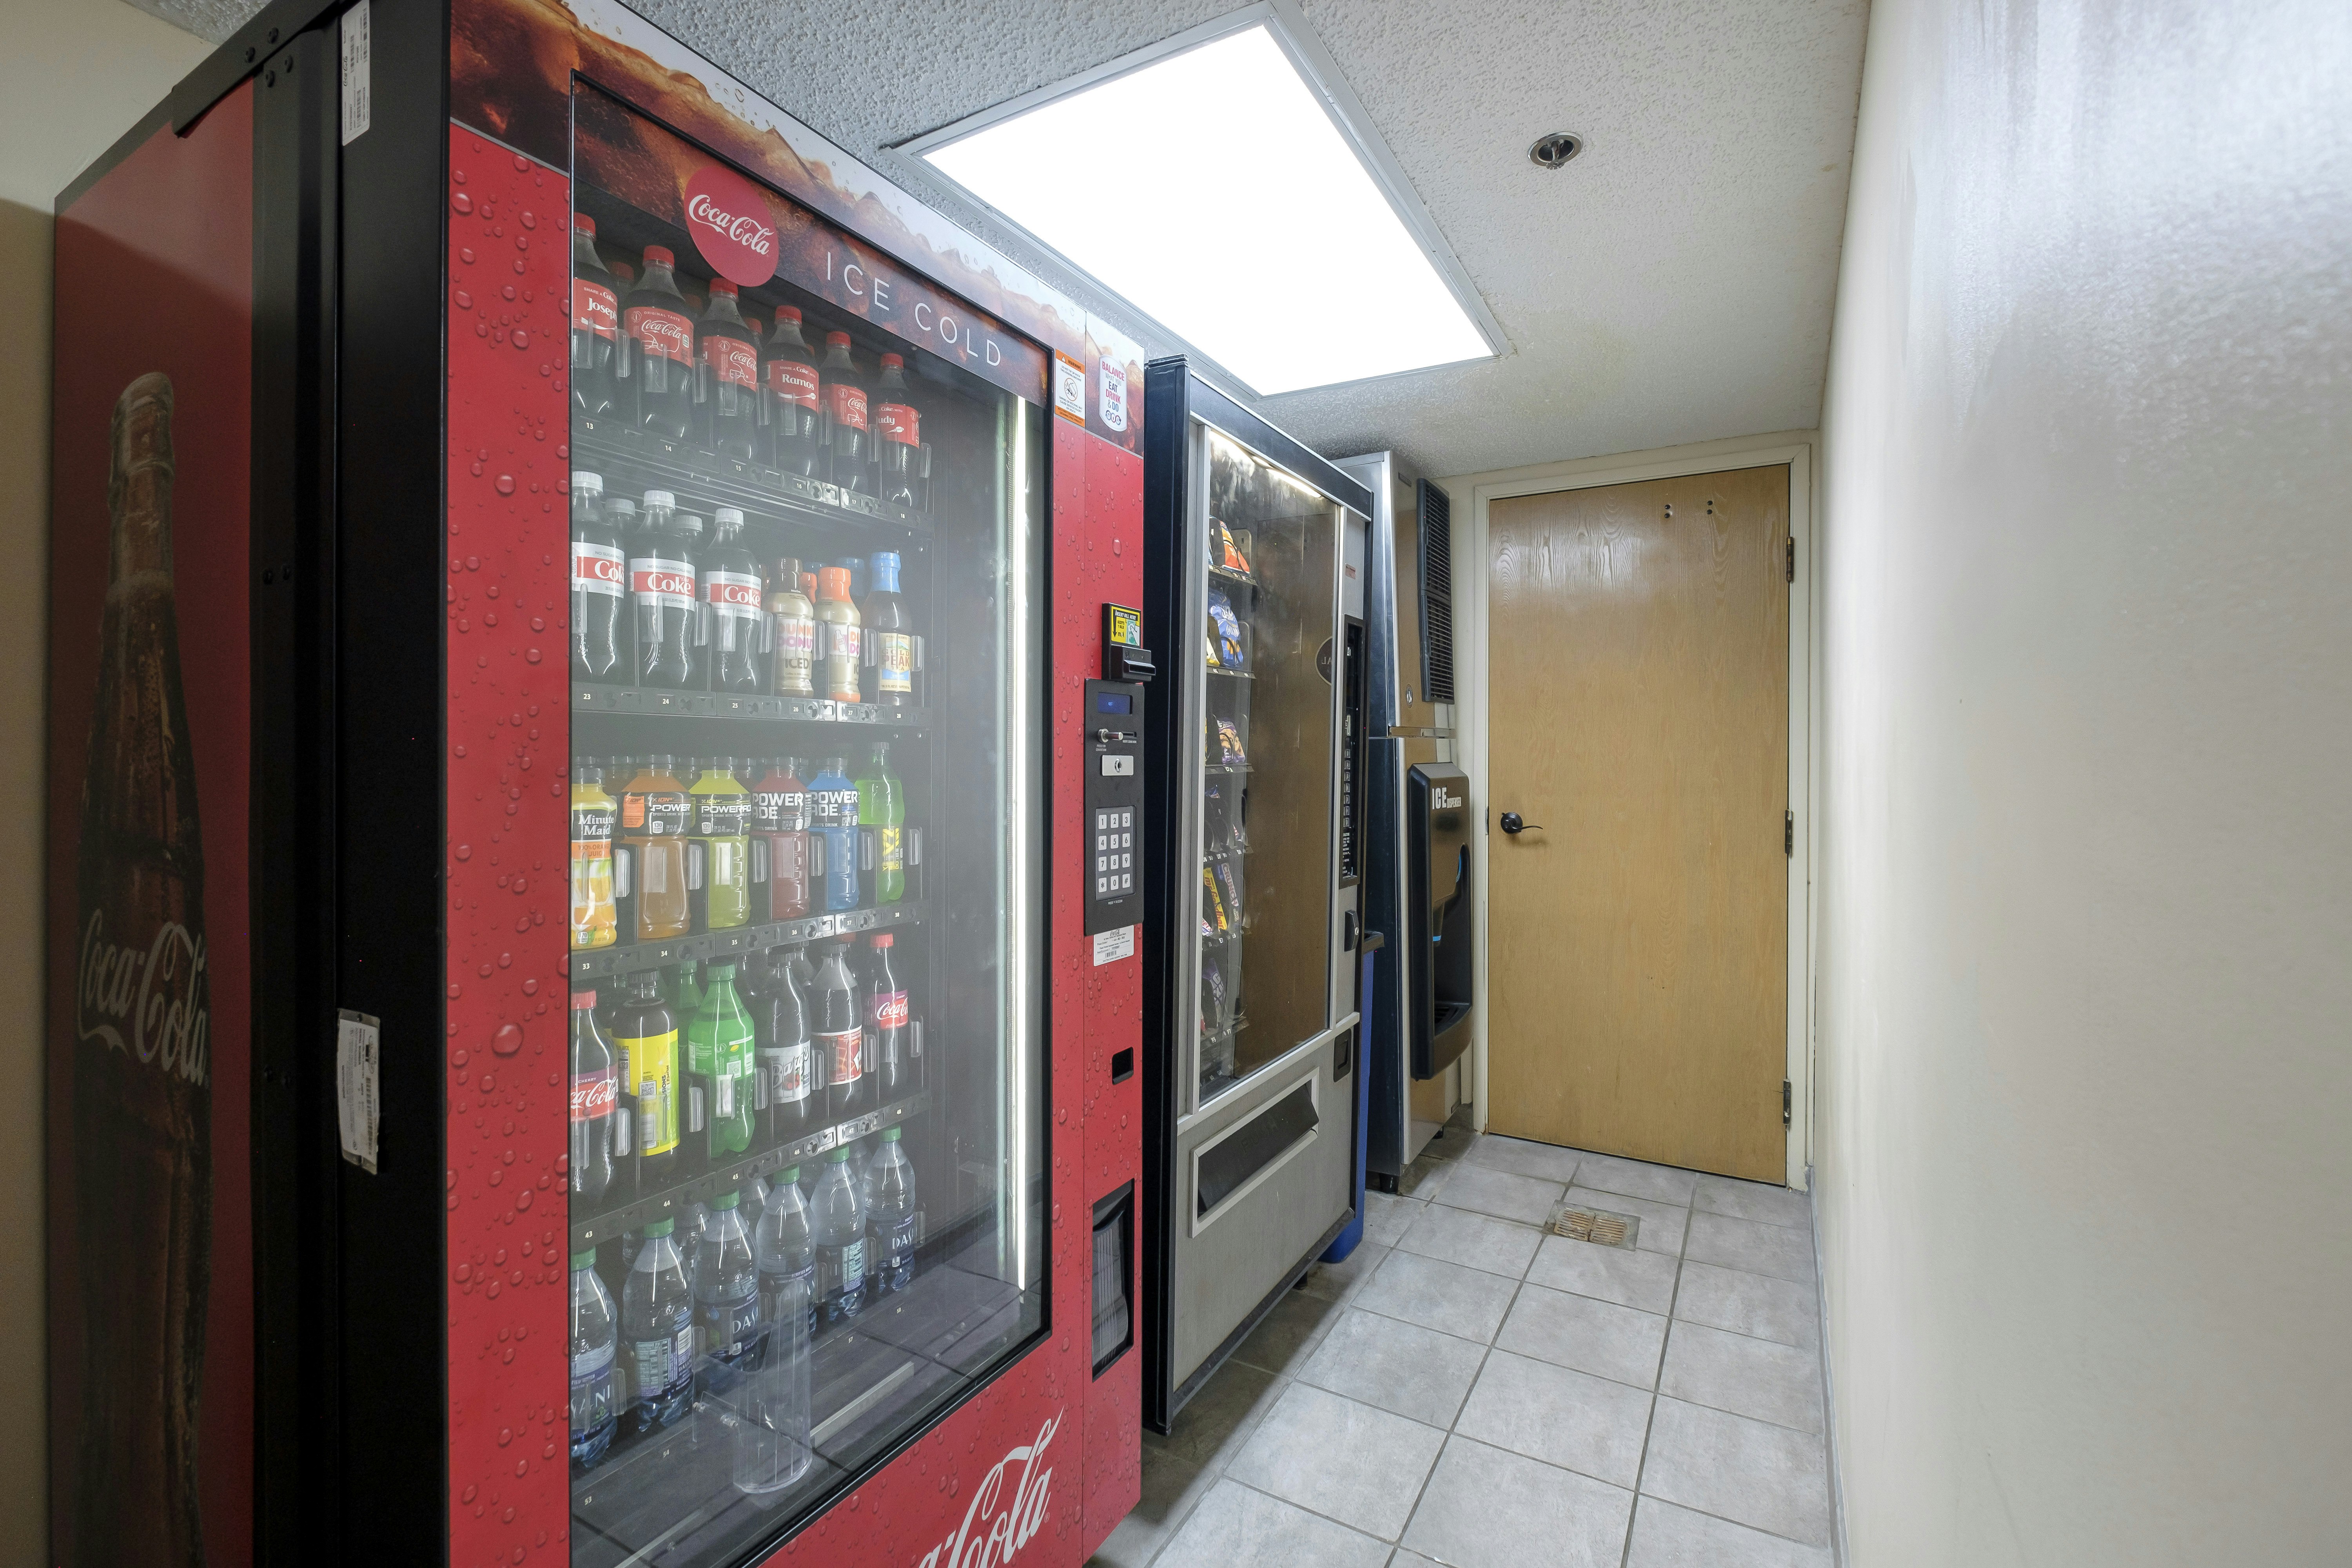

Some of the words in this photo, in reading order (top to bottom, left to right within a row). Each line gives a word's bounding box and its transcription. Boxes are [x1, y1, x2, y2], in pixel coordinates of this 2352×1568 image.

[689, 194, 771, 257] Coca-Cola
[826, 251, 890, 312] ICE
[914, 302, 1002, 367] COLD
[641, 319, 684, 339] Coca-Cola
[796, 366, 809, 375] Coke
[1102, 361, 1125, 381] BALANCE
[1105, 372, 1114, 381] WHAT
[782, 374, 815, 391] Ramos
[1106, 388, 1121, 405] DRINK
[1108, 399, 1111, 408] &
[1112, 403, 1119, 412] DO
[878, 416, 895, 425] udy
[594, 560, 625, 583] Cok
[647, 573, 691, 595] Coke
[724, 586, 760, 606] Coke
[777, 623, 812, 638] DUNK
[785, 658, 809, 669] ICED
[881, 654, 910, 667] PEAK
[752, 793, 804, 806] POWER
[811, 791, 858, 804] POWER
[1432, 787, 1447, 809] ICE
[578, 813, 615, 825] Minute
[583, 824, 611, 835] Maid
[1222, 864, 1239, 907] CRUNCH
[78, 908, 207, 1086] Coca-Cola
[570, 1075, 619, 1109] ca-Cola
[663, 1449, 670, 1458] 54
[584, 1497, 592, 1505] 53
